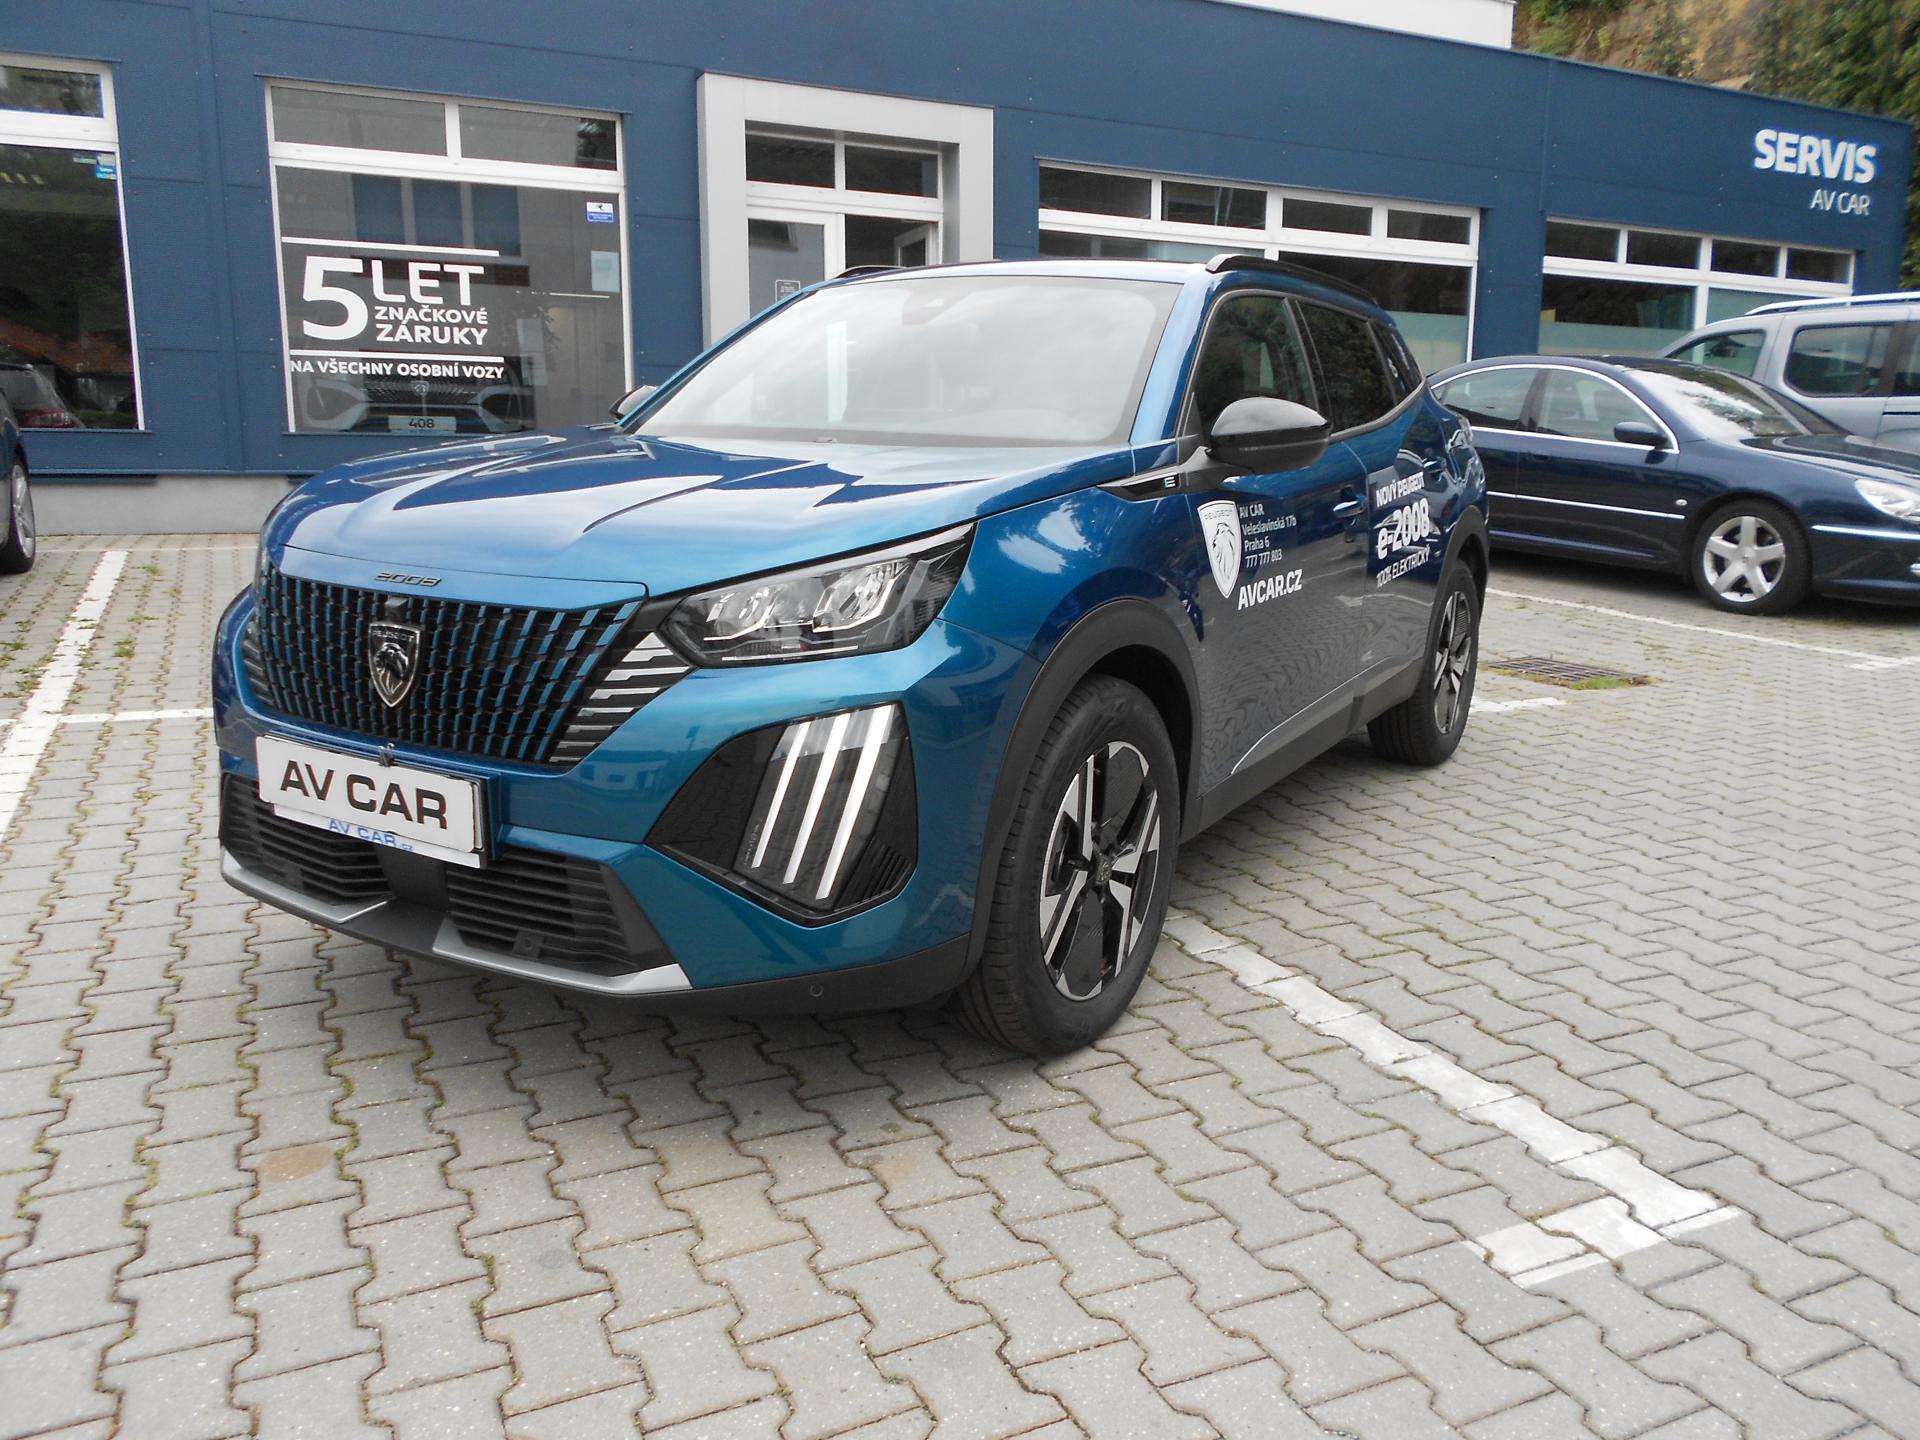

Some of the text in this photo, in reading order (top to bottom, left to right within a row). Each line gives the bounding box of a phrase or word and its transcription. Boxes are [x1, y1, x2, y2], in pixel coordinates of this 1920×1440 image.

[1754, 129, 1877, 184] SERVIS
[1810, 188, 1871, 216] AV CAR
[302, 256, 485, 340] 5 LET
[374, 303, 488, 325] ZNAČKOVÉ
[376, 320, 489, 346] ZÁRUKY
[290, 358, 505, 379] NA VŠECHNY OSOBNÍ VOZY
[408, 418, 435, 429] 408
[1164, 476, 1176, 488] E
[1376, 480, 1396, 508] NOVÝ
[1239, 503, 1265, 518] AV CAR
[1377, 498, 1430, 560] e-2008
[1244, 535, 1270, 552] Praha 6
[1245, 554, 1258, 568] 777
[1258, 551, 1270, 565] 777
[375, 571, 442, 587] 2008
[1238, 569, 1303, 610] AVCAR.CZ
[280, 760, 448, 830] AV CAR
[329, 819, 350, 833] AV
